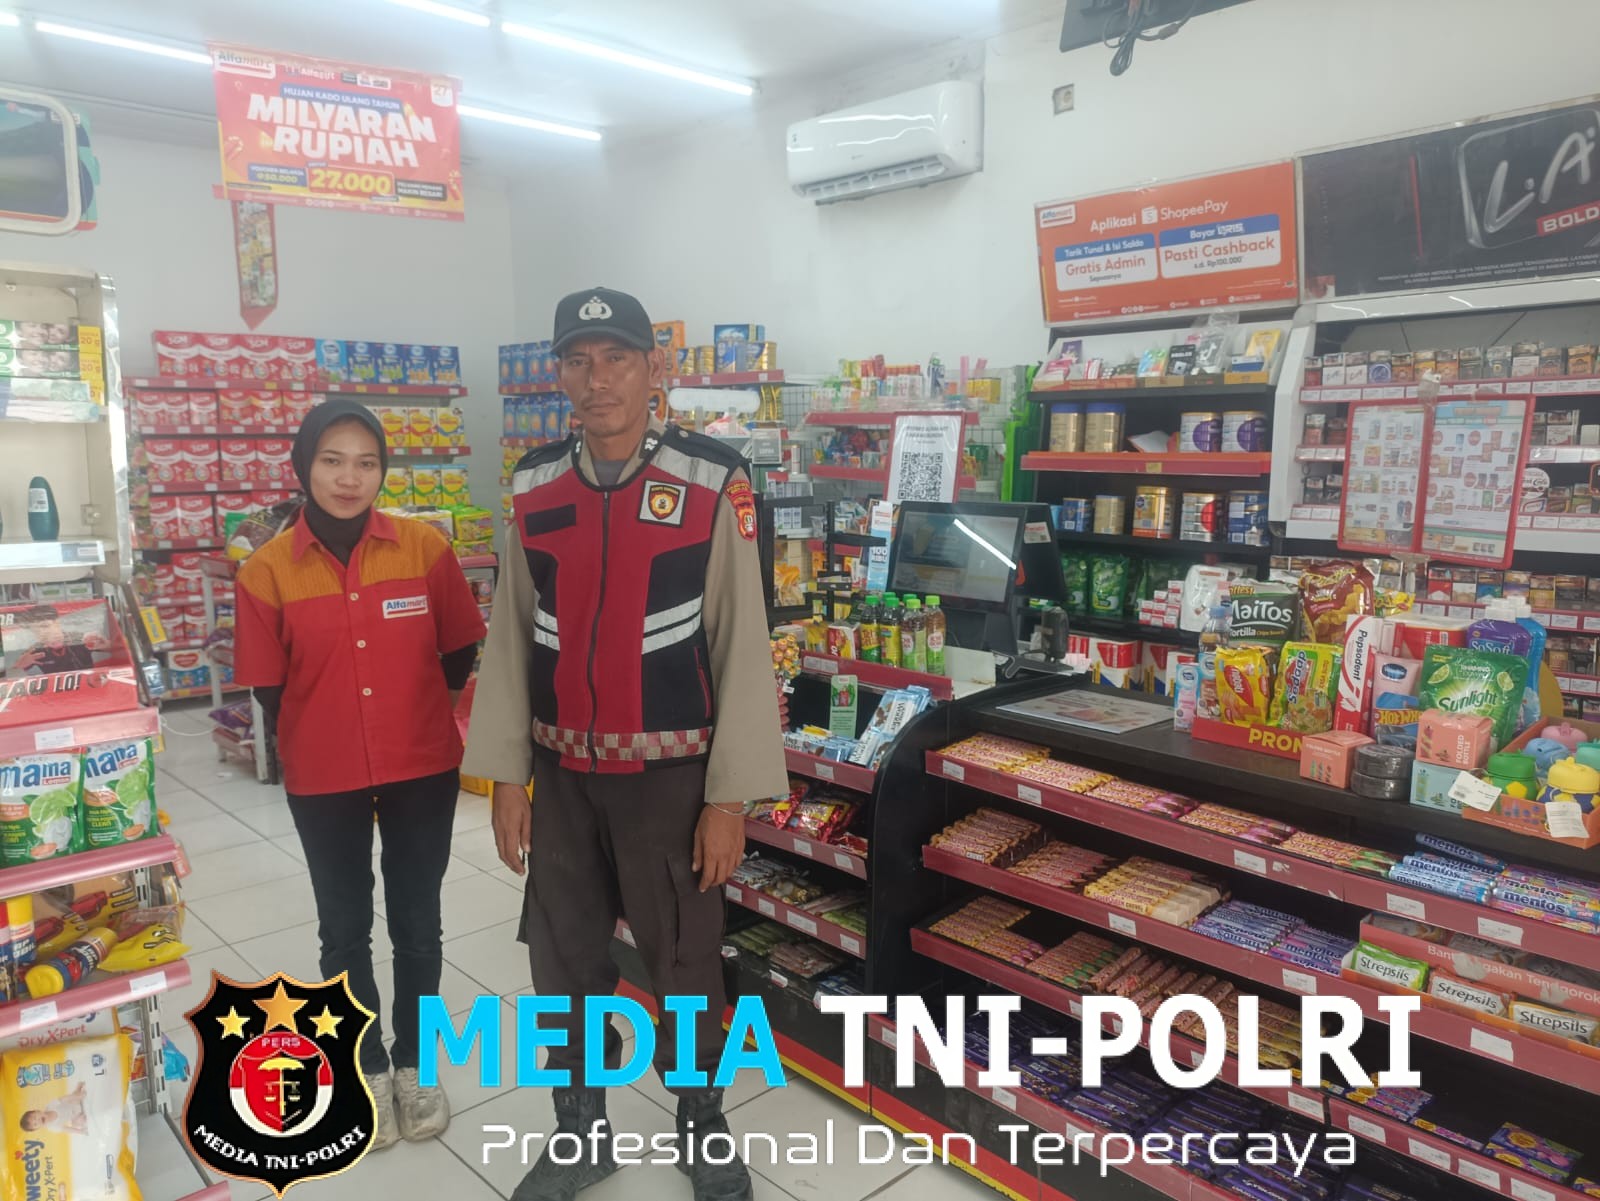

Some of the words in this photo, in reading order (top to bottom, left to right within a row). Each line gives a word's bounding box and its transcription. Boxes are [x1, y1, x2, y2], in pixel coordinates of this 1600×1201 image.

[283, 87, 314, 98] HUJAN
[315, 91, 340, 102] KADO
[341, 95, 370, 106] ULANG
[371, 98, 401, 110] TAHUN
[247, 93, 437, 143] MILYARAN
[272, 126, 419, 168] RUPIAH
[311, 169, 391, 195] 27.000
[1090, 213, 1137, 234] Aplikasi
[1160, 199, 1229, 222] ShopeePay
[1542, 206, 1600, 233] BOLD
[1122, 239, 1144, 249] Saldo
[1189, 228, 1215, 241] Bayar
[1164, 247, 1198, 263] Pasti
[1201, 236, 1275, 258] Cashback
[1065, 261, 1102, 276] Gratis
[1104, 256, 1146, 271] Admin
[81, 336, 94, 346] 20
[81, 362, 94, 372] 20
[386, 599, 426, 610] Alfamart
[1352, 629, 1368, 681] Pepsodent
[1438, 689, 1498, 712] Sunlight
[1423, 834, 1475, 861] mentos
[1396, 873, 1433, 890] mentos
[1503, 890, 1567, 914] mentos
[1360, 955, 1410, 982] Strepsils
[1437, 981, 1498, 1009] Strepsils
[1520, 1010, 1588, 1035] Strepsils
[22, 1139, 45, 1201] weety
